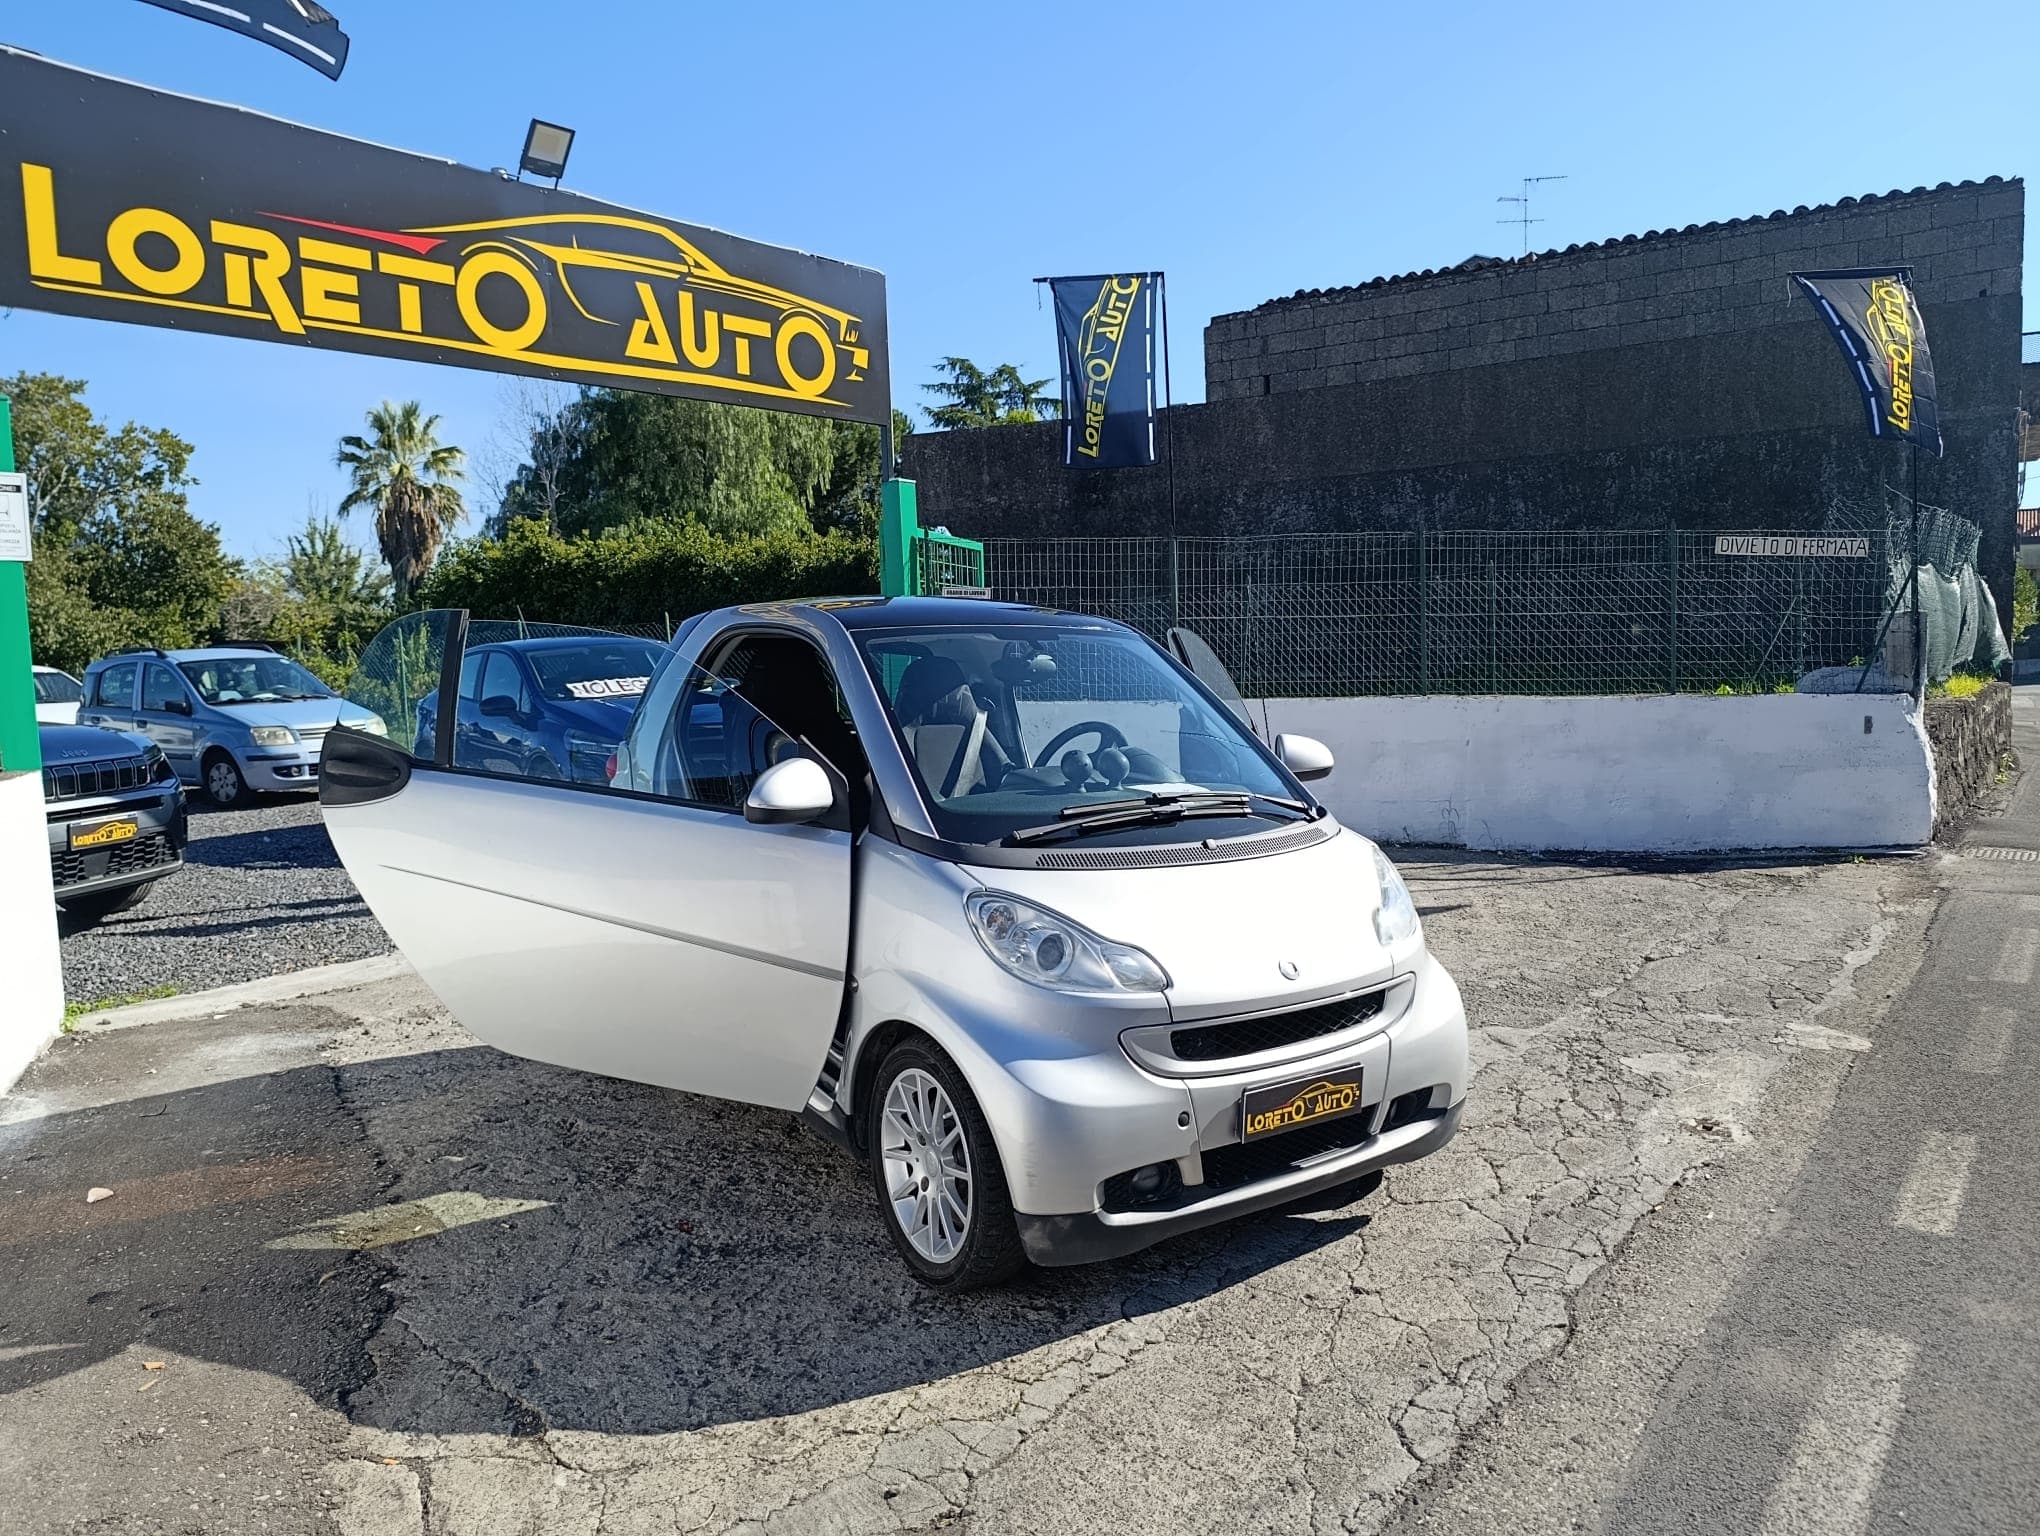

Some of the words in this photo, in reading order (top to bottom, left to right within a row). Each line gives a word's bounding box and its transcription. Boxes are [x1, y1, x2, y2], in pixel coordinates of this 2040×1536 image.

[22, 162, 548, 352] LORETO
[625, 280, 837, 397] AUTO
[1879, 286, 1906, 335] AUTO
[1078, 358, 1111, 458] LORETO
[1097, 275, 1139, 342] AUTO
[1888, 343, 1912, 431] LORETO
[1720, 537, 1779, 554] DIVIETO
[1785, 539, 1798, 554] DI
[1802, 539, 1867, 556] FERMATA
[61, 748, 89, 758] Jeep
[73, 830, 107, 846] LORETO
[112, 826, 133, 839] AUTO
[1247, 1100, 1304, 1133] LORETO
[1315, 1088, 1352, 1113] AUTO
